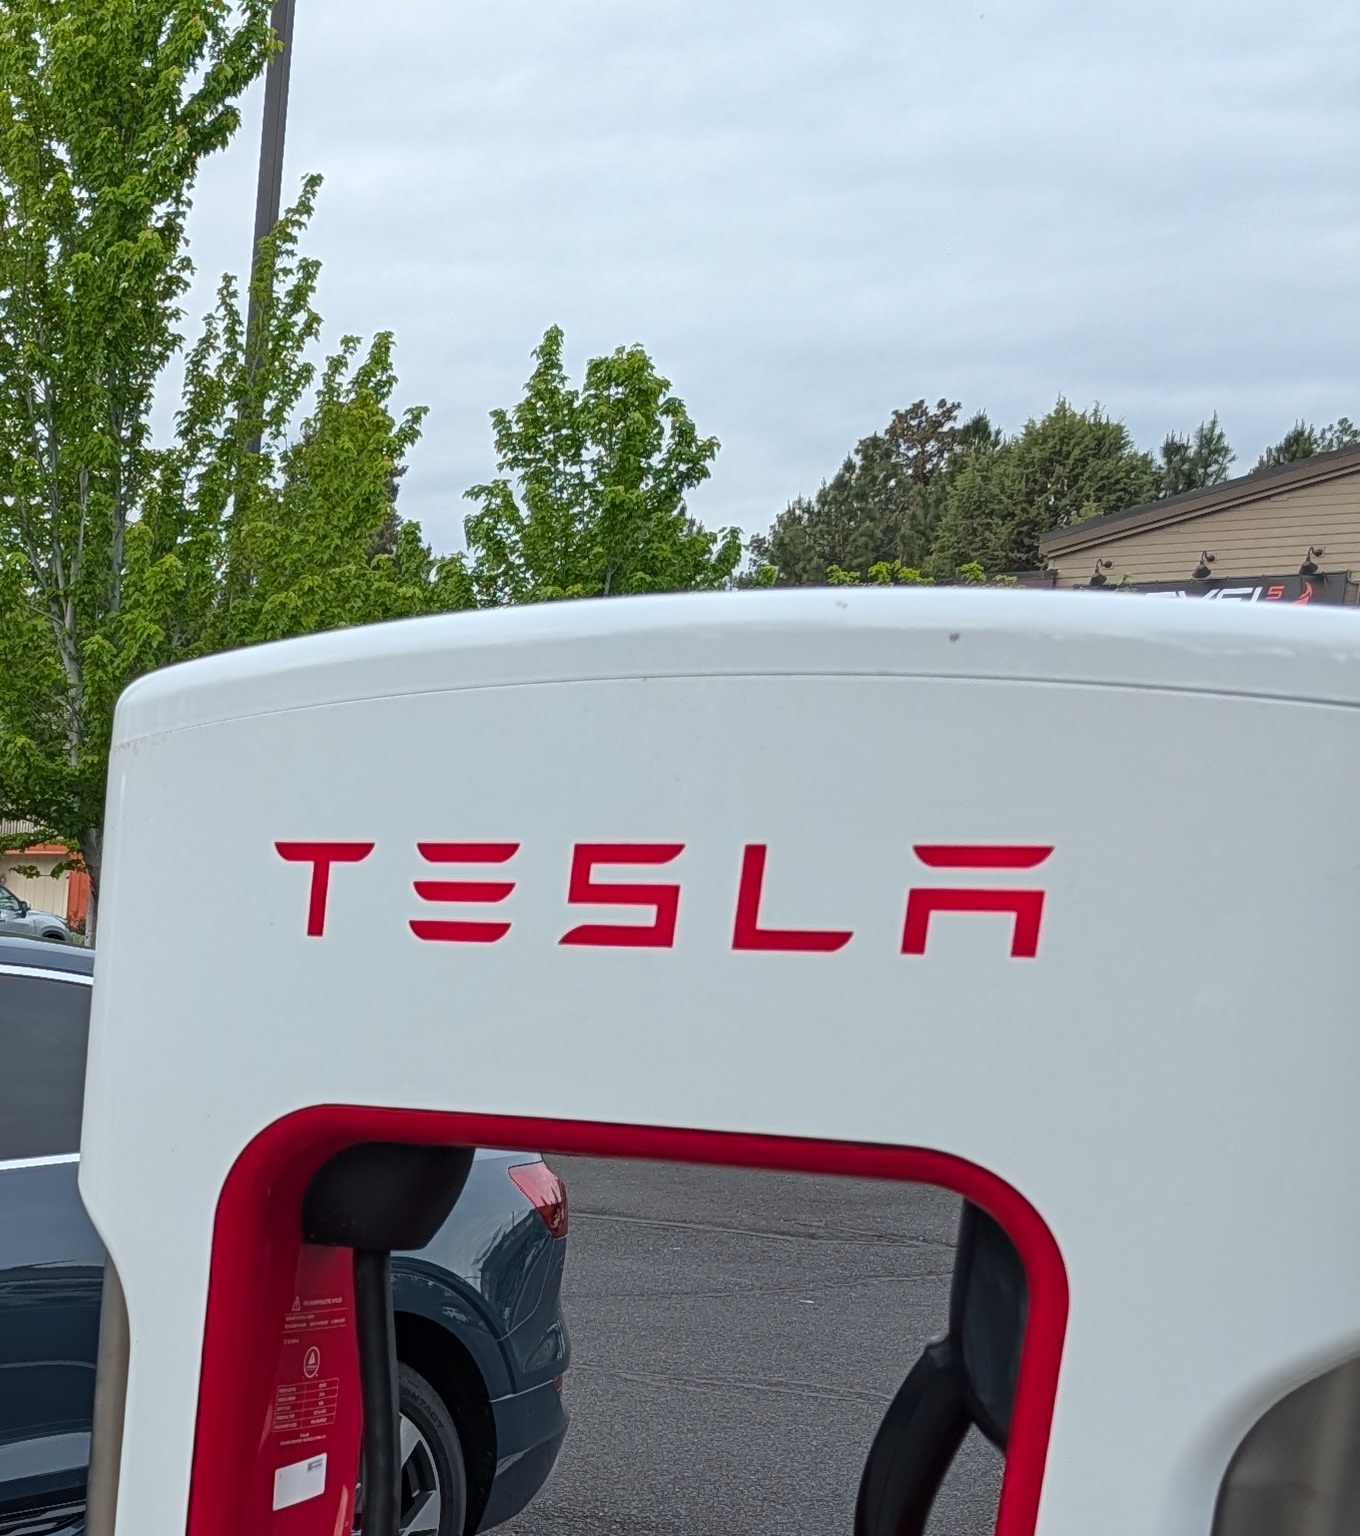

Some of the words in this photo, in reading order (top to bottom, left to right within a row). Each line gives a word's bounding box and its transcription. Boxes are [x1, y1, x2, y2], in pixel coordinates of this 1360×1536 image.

[1265, 585, 1285, 601] 5
[274, 841, 1056, 959] TESLA
[399, 1387, 446, 1429] ONTACT
